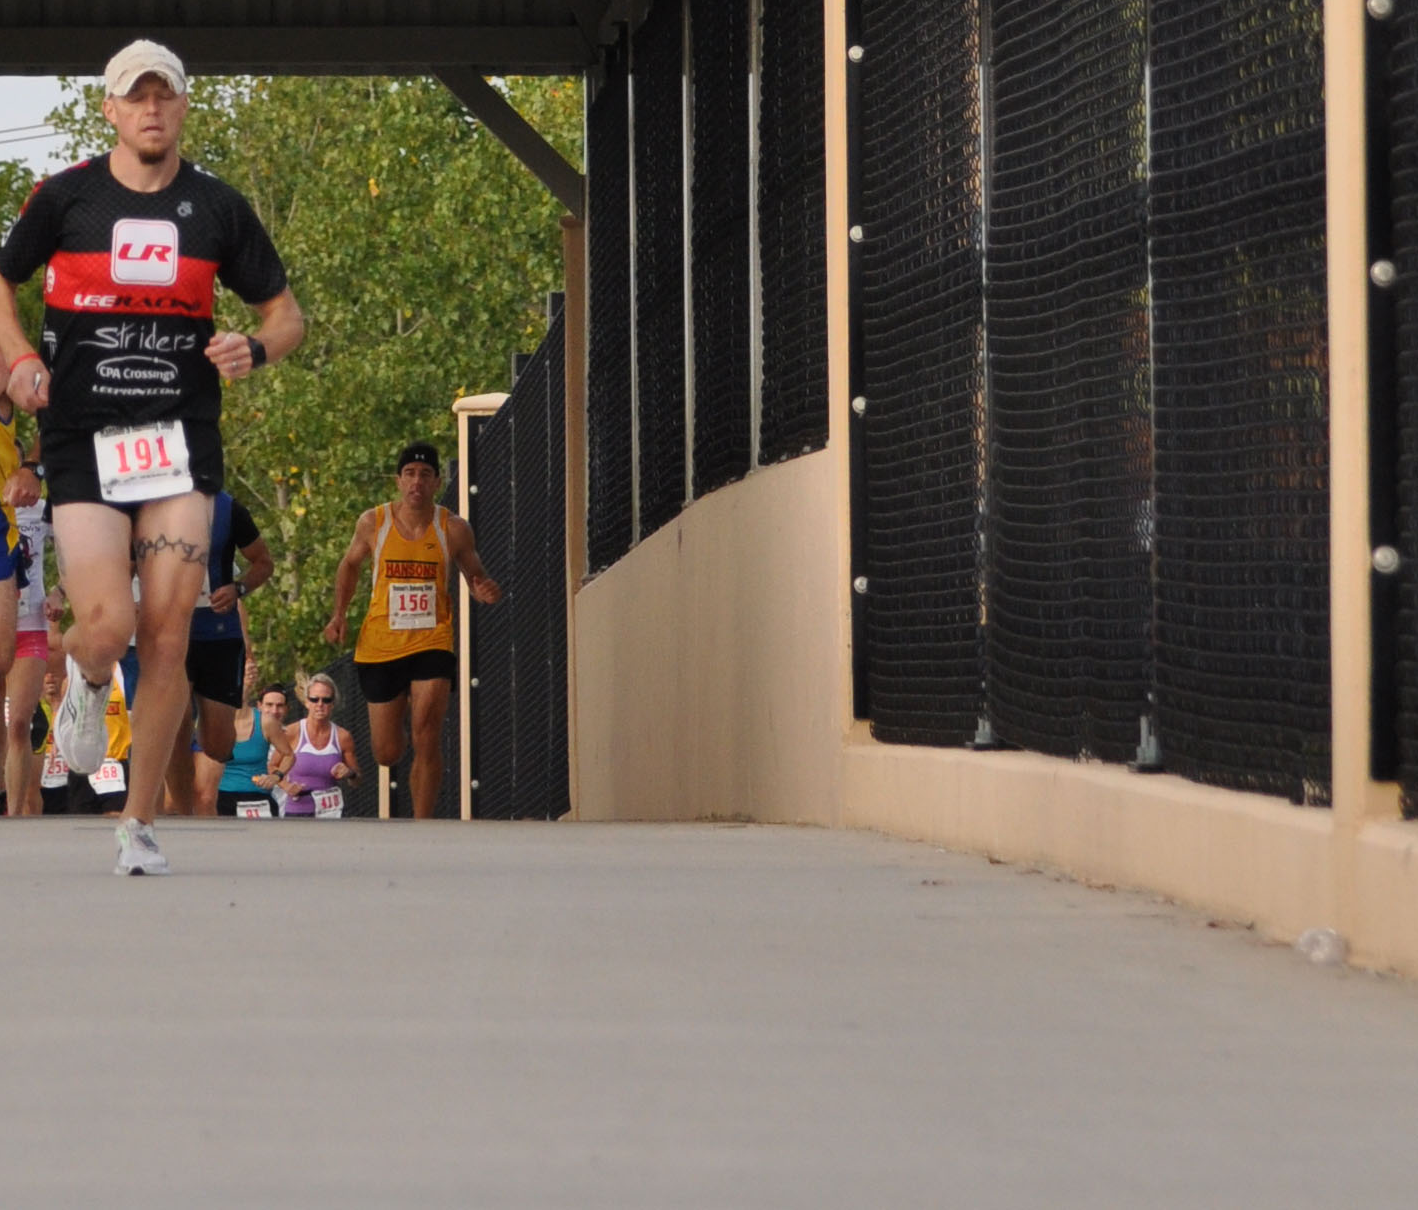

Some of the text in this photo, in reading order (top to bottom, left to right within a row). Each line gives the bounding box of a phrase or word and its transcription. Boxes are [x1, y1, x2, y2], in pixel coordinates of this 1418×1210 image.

[118, 243, 173, 262] LR
[78, 322, 196, 351] Striders
[99, 366, 176, 382] CPA Crossings
[115, 435, 172, 473] 191
[386, 563, 437, 576] HANSONS
[399, 593, 429, 612] 156
